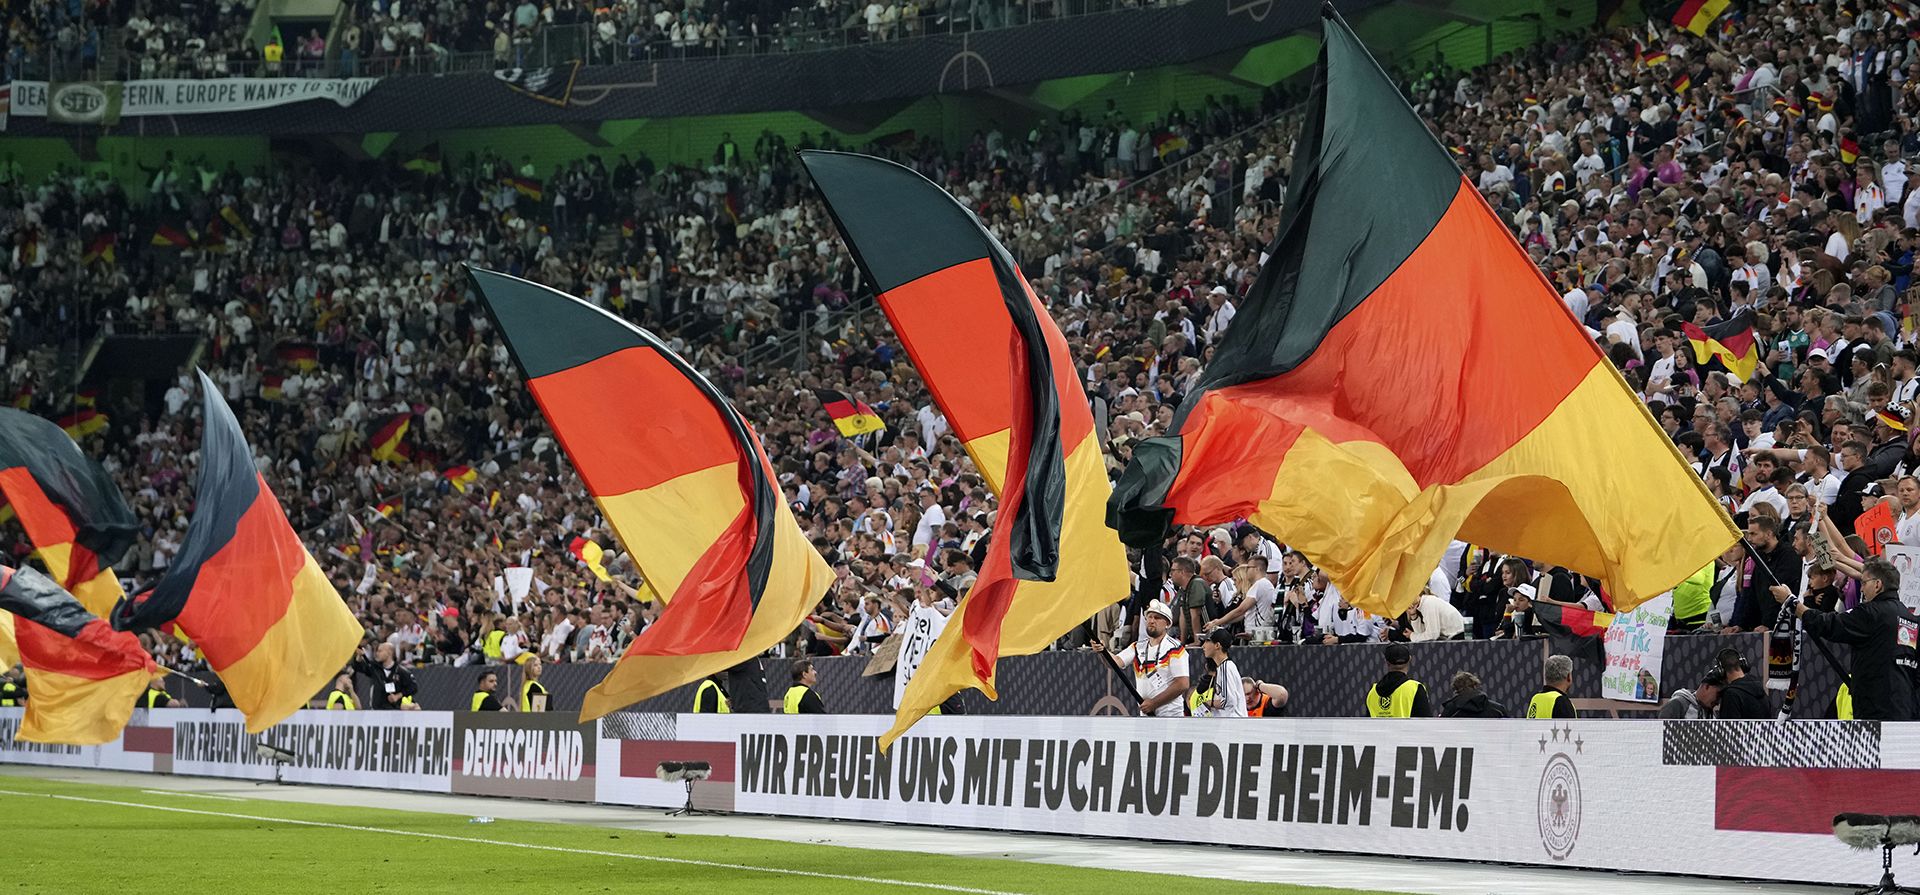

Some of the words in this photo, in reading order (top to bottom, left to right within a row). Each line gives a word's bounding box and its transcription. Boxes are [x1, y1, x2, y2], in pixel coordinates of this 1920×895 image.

[17, 86, 47, 106] DEA
[176, 84, 238, 104] EUROPE
[244, 82, 297, 101] WANTS
[302, 80, 320, 93] TO
[176, 722, 195, 761] WIR
[197, 722, 239, 763] FREUEN
[325, 725, 354, 770] AUF
[355, 726, 380, 771] DIE
[381, 726, 451, 777] HEIM-EM!
[462, 728, 583, 781] DEUTSCHLAND
[740, 733, 788, 795] WIR
[792, 735, 894, 799] FREUEN
[899, 736, 958, 804] UNS
[962, 737, 1021, 806] MIT
[1024, 738, 1116, 812] EUCH
[1117, 741, 1193, 816] AUF
[1196, 742, 1262, 820] DIE
[1268, 744, 1474, 832] HEIM-EM!
